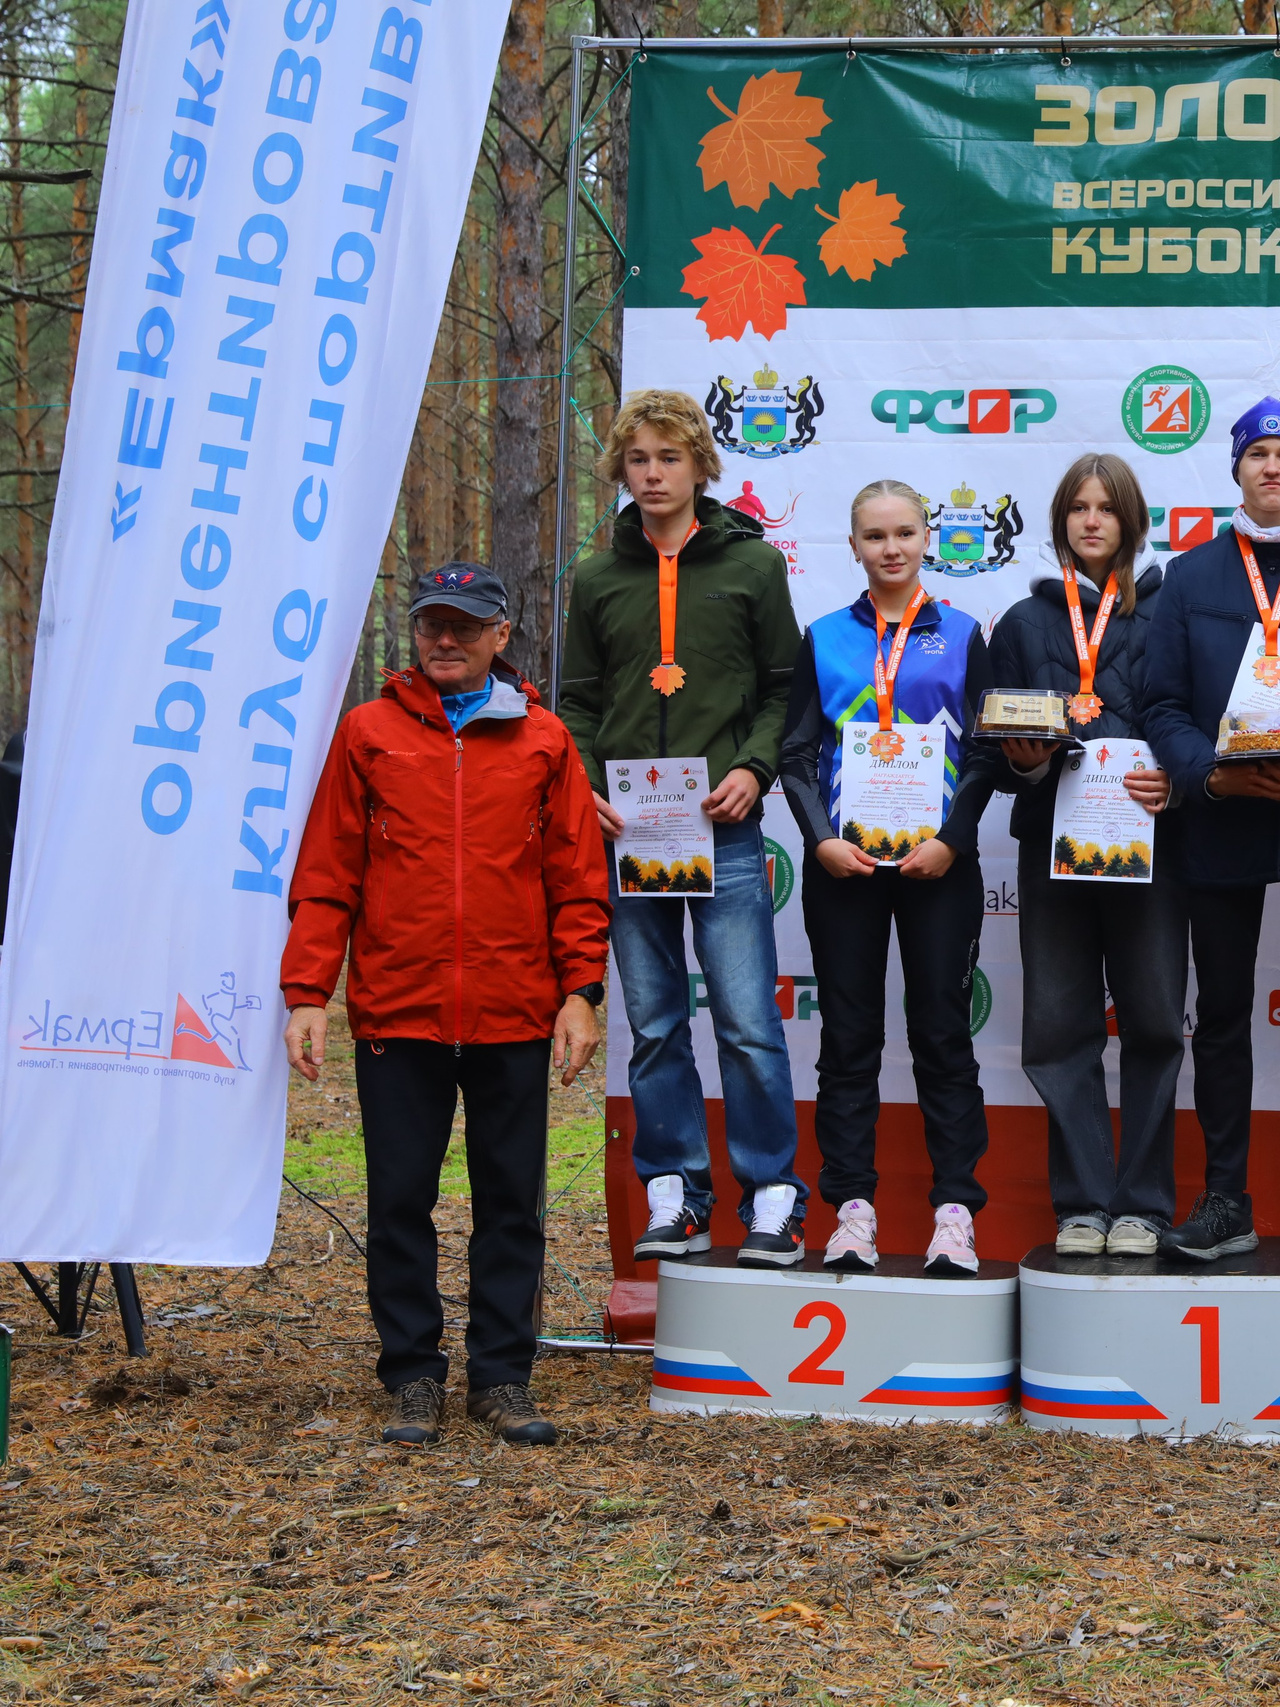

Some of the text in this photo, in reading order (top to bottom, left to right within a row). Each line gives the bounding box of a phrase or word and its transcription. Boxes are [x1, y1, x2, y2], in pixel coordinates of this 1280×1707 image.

[1126, 369, 1207, 441] ФЕДЕРАЦИЯ СПОРТИВНОГО ОРИЕНТИРОВАНИЯ
[1126, 414, 1185, 451] ТЮМЕНСКОЙ ОБЛАСТИ
[766, 541, 798, 550] БОК
[1249, 554, 1260, 576] ОСЕНЬ
[1256, 578, 1269, 610] ЗОЛОТАЯ
[1275, 661, 1280, 669] 1
[1089, 699, 1095, 707] 1
[890, 735, 898, 744] 2
[869, 759, 919, 769] ДИПЛОМ
[1082, 774, 1125, 784] ДИПЛО
[636, 794, 686, 805] ДИПЛОМ
[970, 977, 988, 1032] ОРИЕНТИРОВАНИЯ
[788, 1300, 846, 1386] 2
[1181, 1306, 1220, 1404] 1
